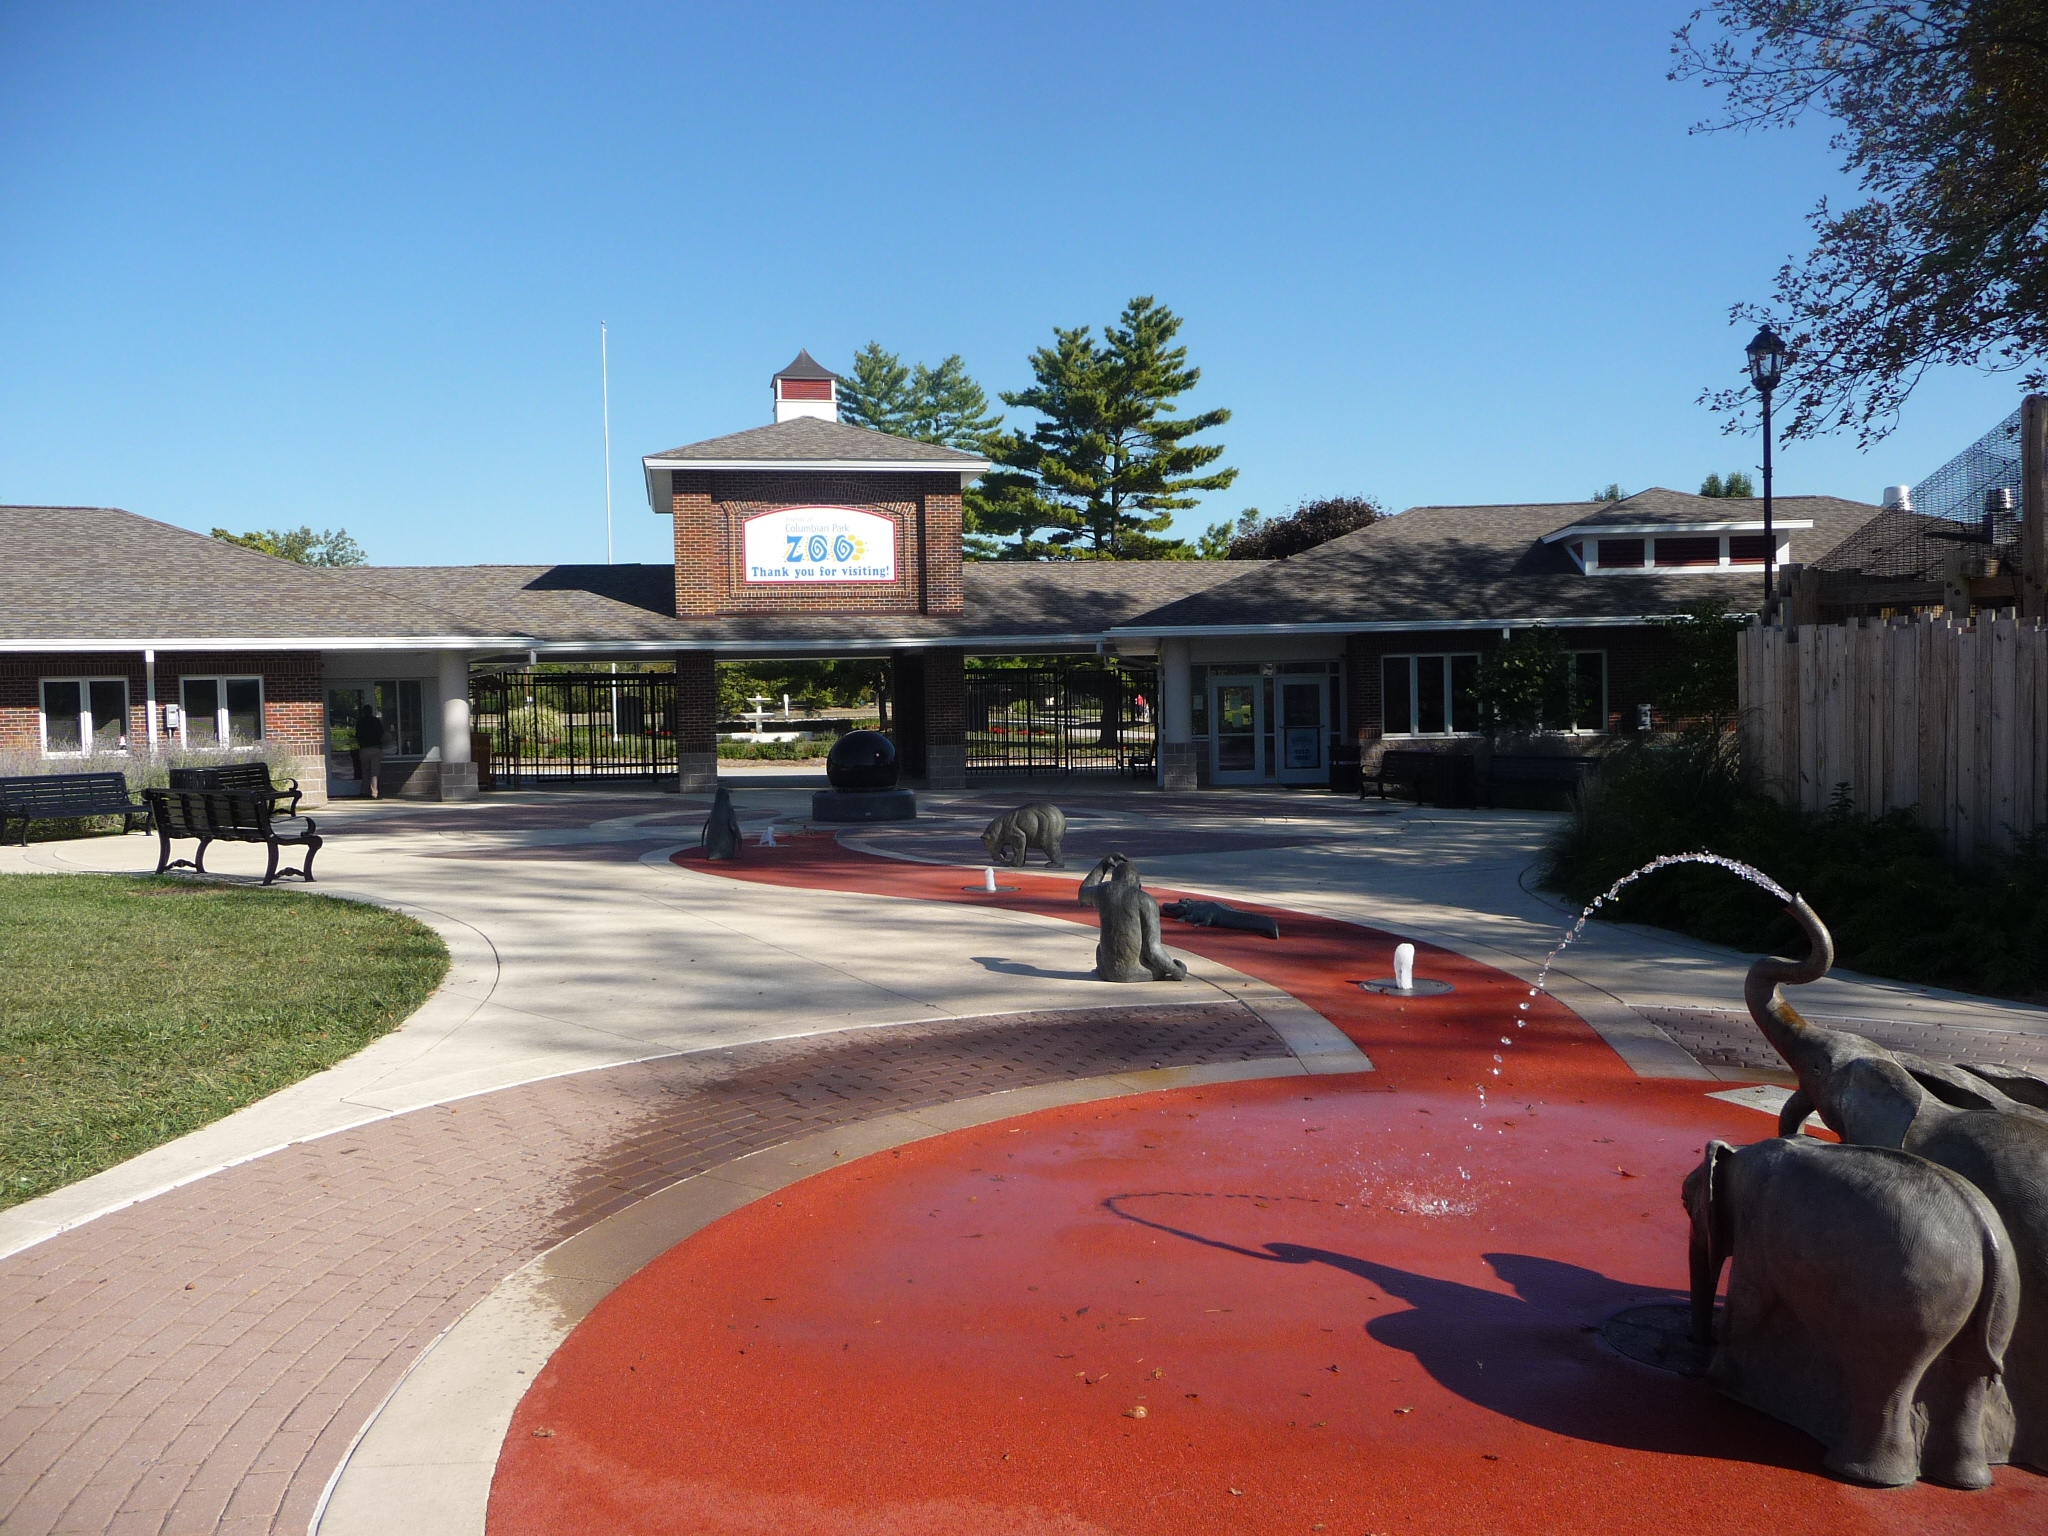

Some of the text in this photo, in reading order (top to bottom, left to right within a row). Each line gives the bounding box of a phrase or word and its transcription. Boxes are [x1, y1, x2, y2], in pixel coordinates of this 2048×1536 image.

[785, 523, 850, 533] Columbian Park
[786, 534, 855, 563] ZOO
[751, 565, 890, 579] Thank you for visiting!
